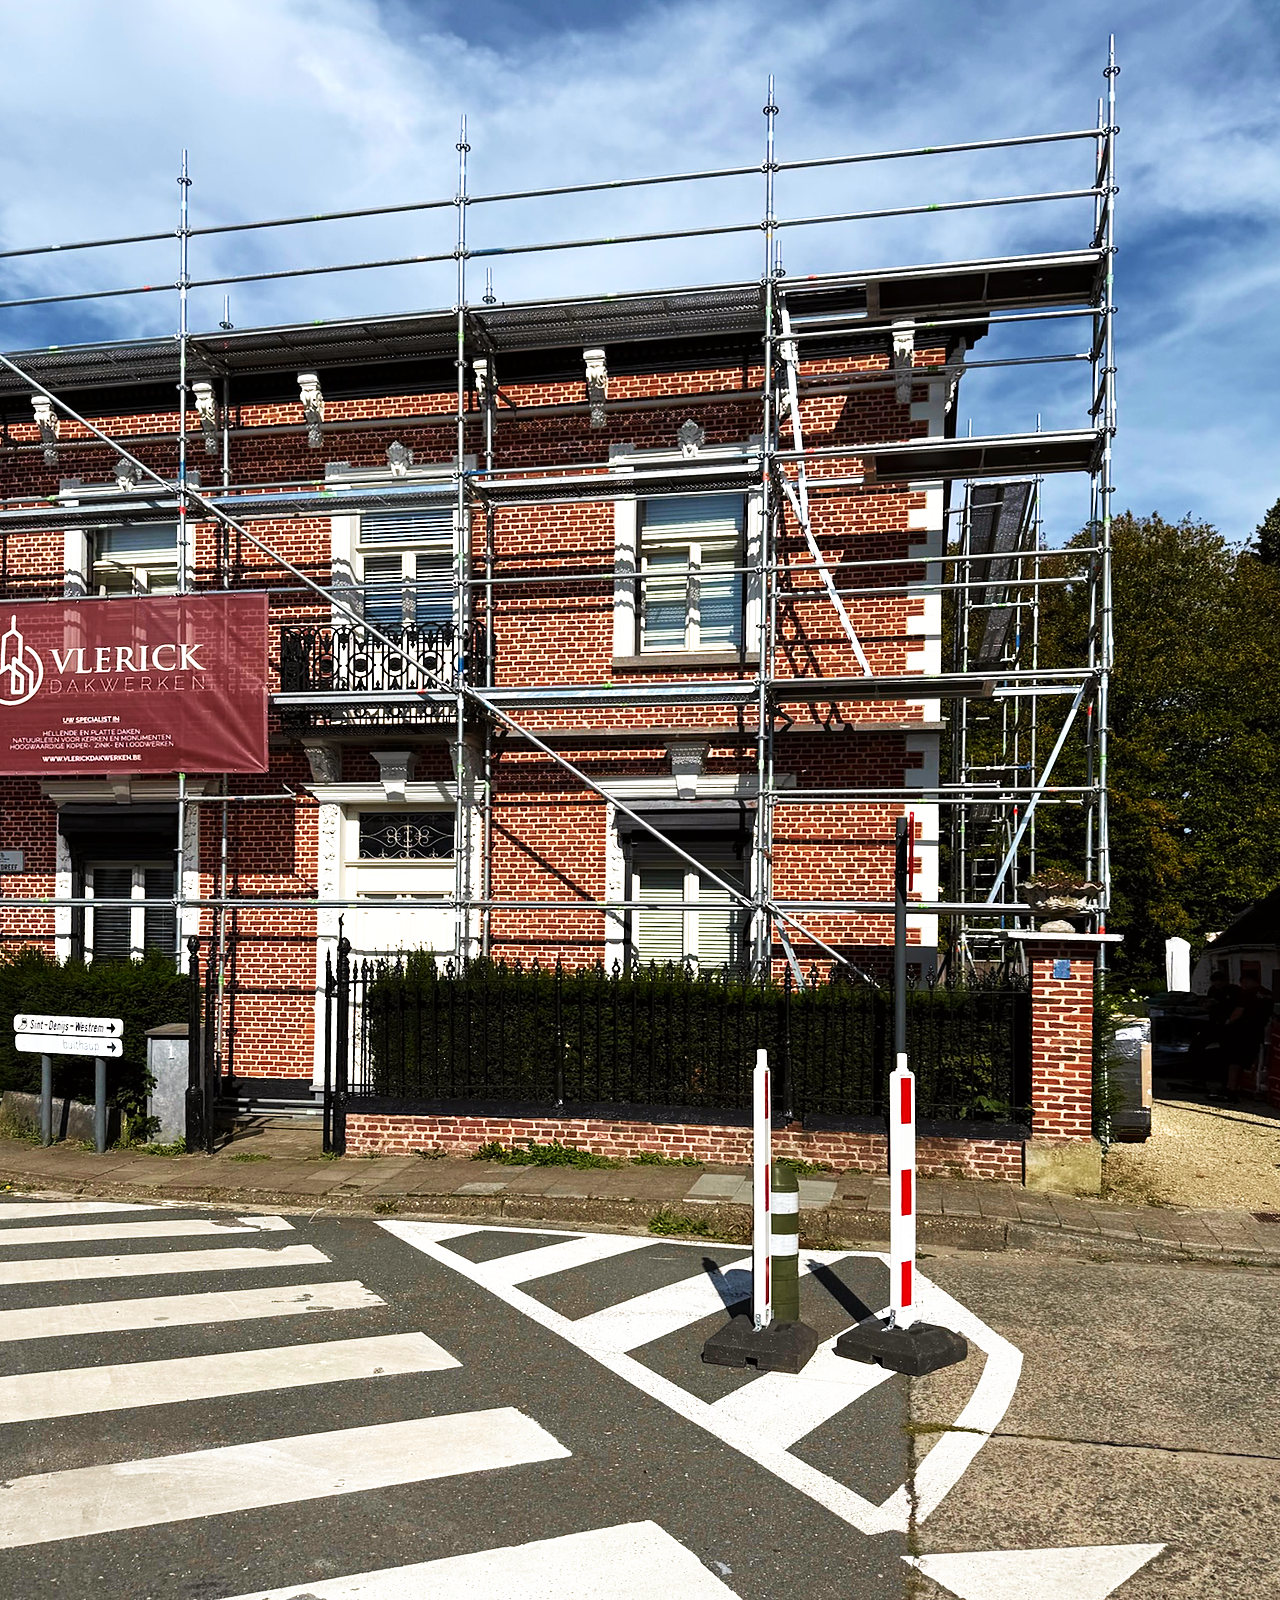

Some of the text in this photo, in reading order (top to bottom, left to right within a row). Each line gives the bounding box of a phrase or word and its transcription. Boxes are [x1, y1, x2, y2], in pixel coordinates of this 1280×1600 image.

[49, 643, 207, 674] VLERICK
[49, 675, 206, 694] DAKWERKEN
[112, 715, 120, 723] IN
[41, 754, 142, 762] WWW.VLERICKDAKWERKEN.BE
